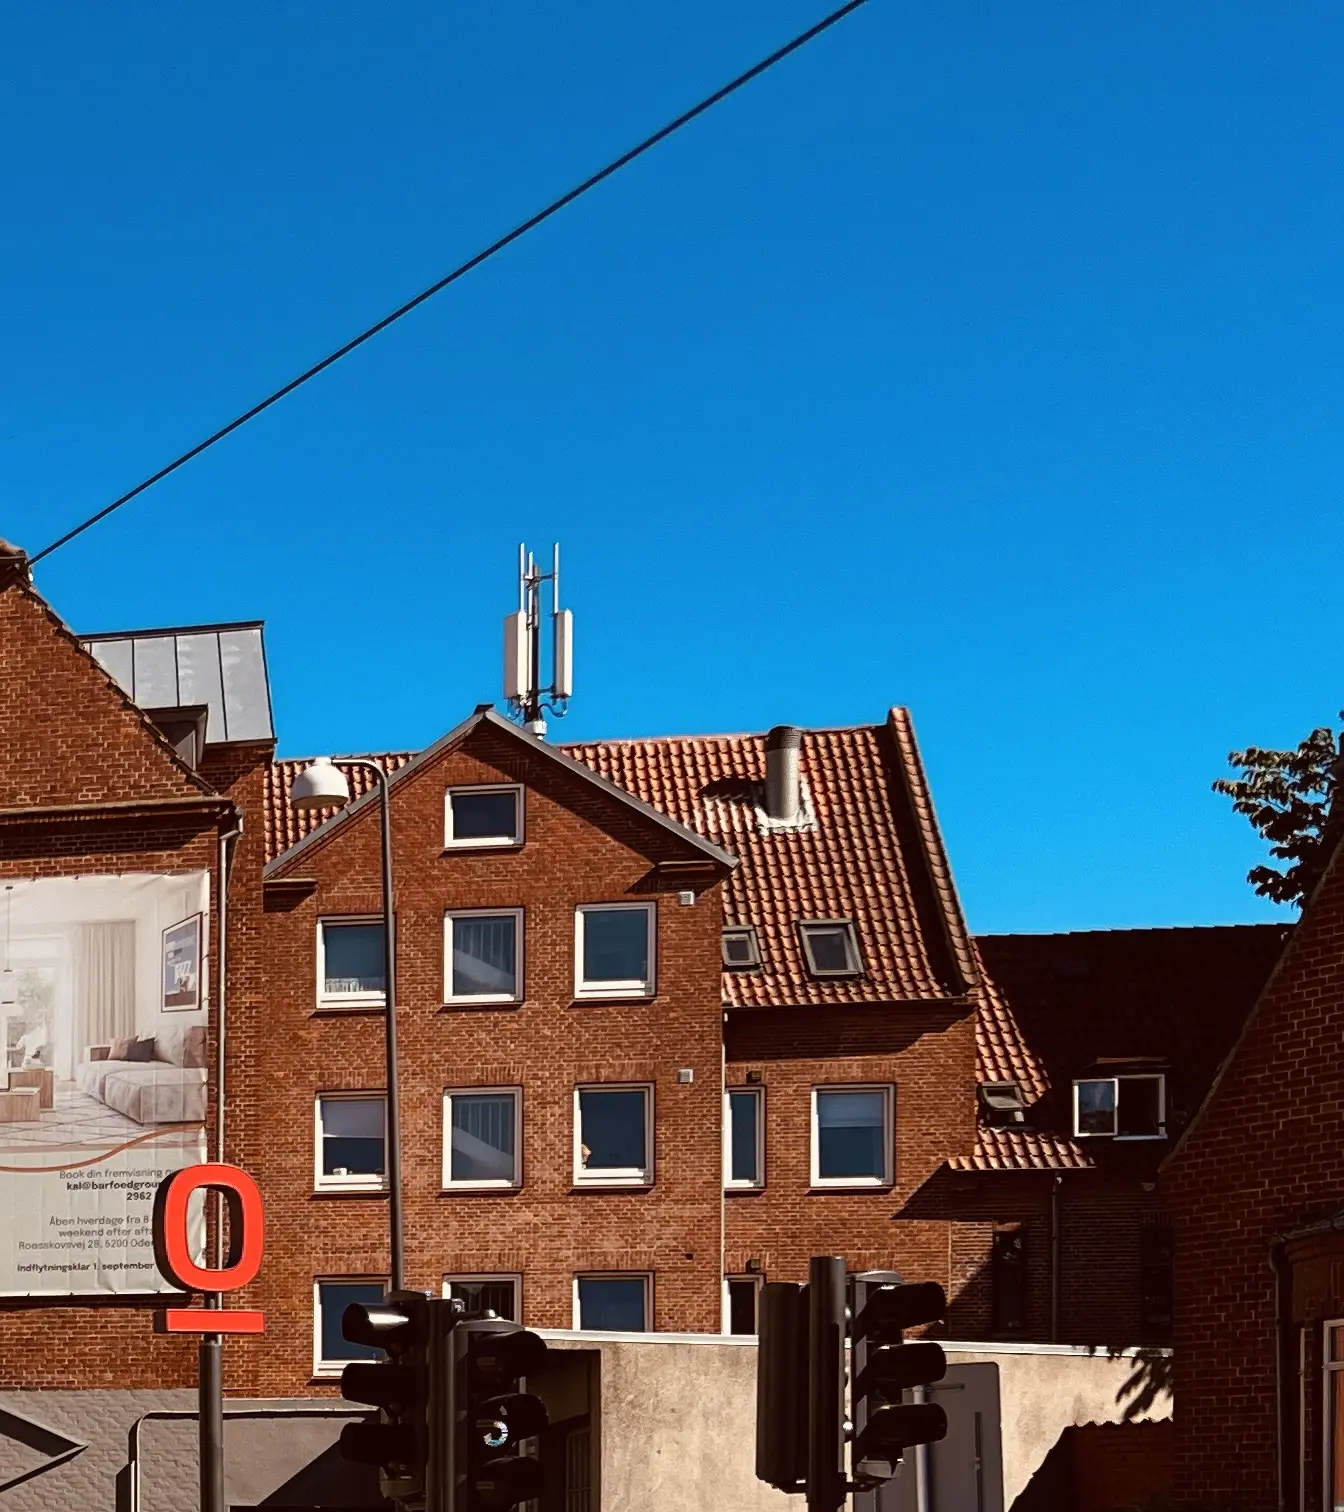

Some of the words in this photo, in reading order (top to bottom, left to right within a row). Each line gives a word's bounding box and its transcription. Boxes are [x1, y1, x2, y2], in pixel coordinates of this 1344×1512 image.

[59, 1170, 84, 1180] Book
[86, 1169, 102, 1178] din
[104, 1168, 162, 1179] fremvisning
[66, 1180, 162, 1191] kal@barfoedgrou
[77, 1215, 124, 1226] hverdage
[126, 1215, 141, 1224] fra
[58, 1229, 104, 1238] weekend
[130, 1238, 154, 1248] Ode
[17, 1263, 91, 1274] Indflytningsklar
[101, 1261, 155, 1272] september
